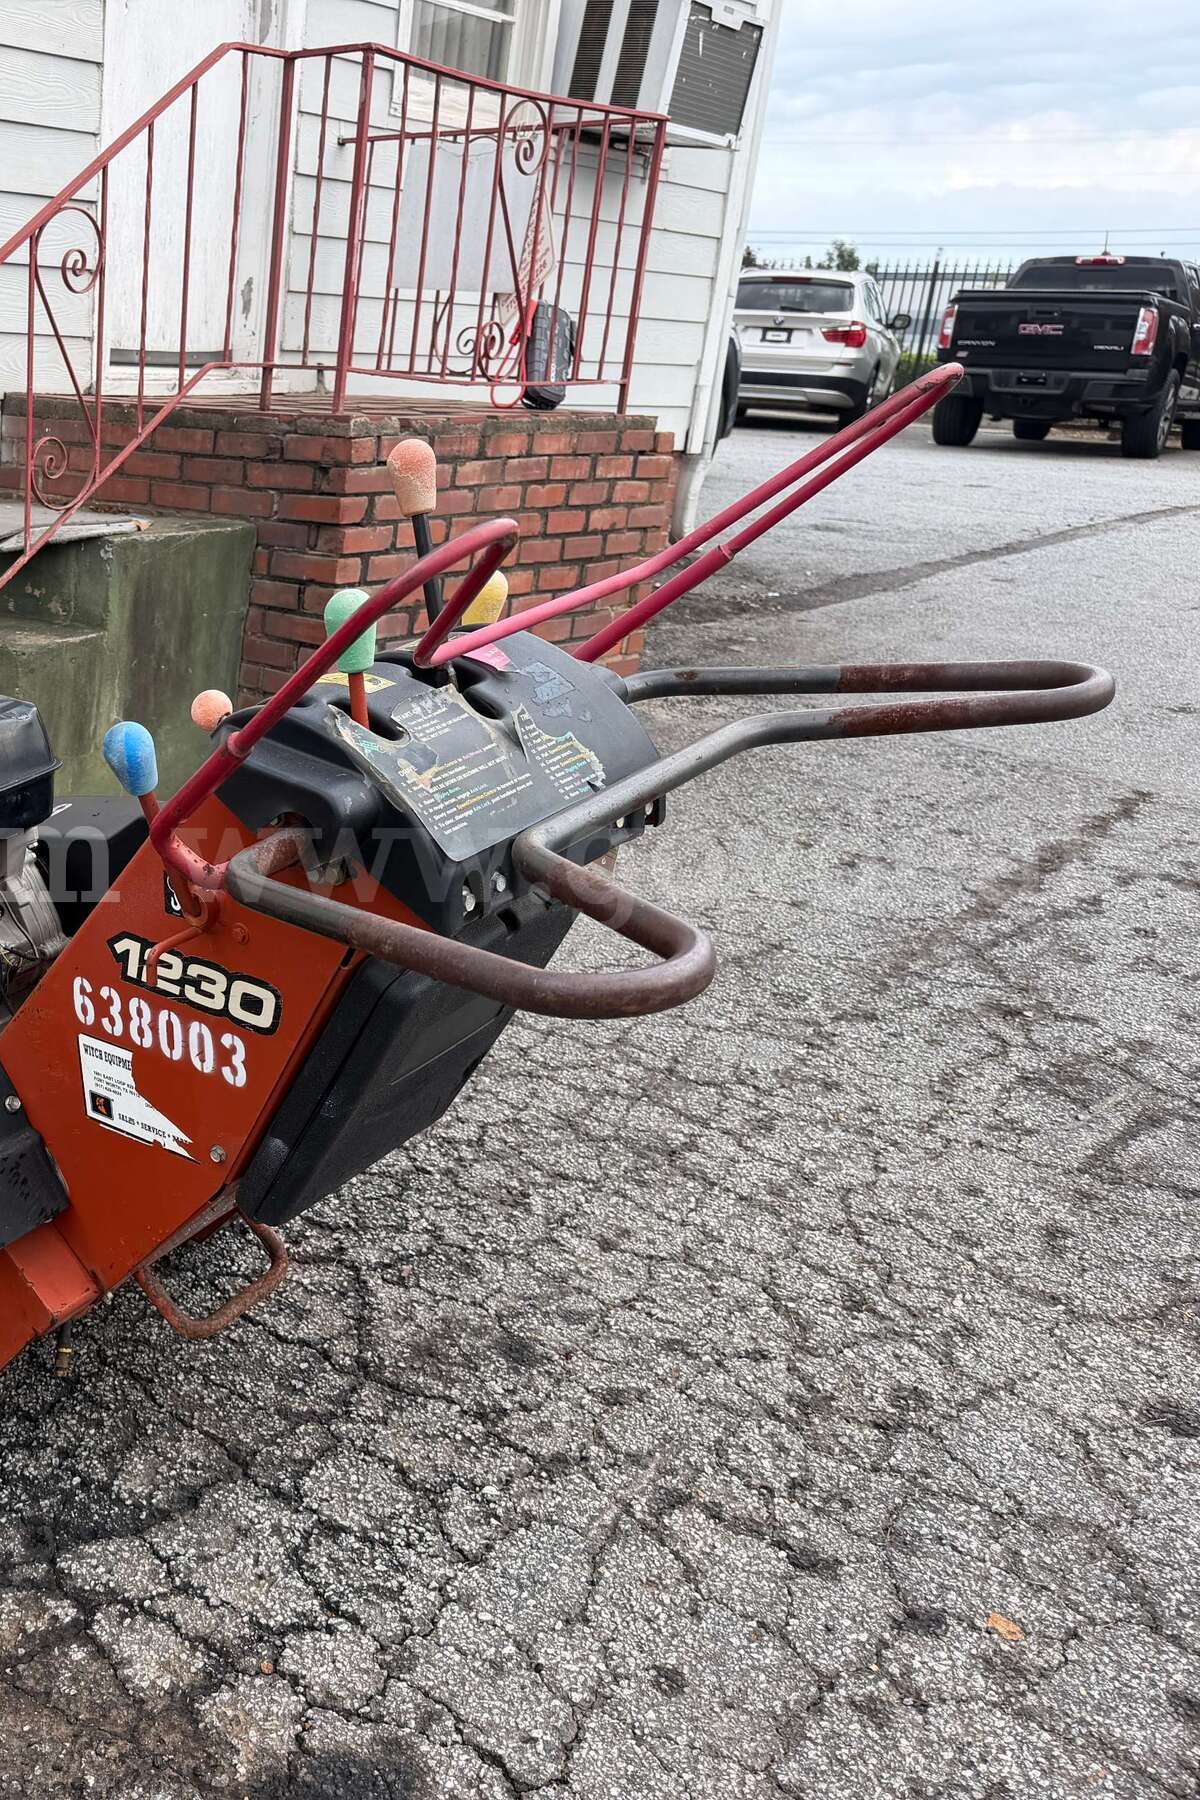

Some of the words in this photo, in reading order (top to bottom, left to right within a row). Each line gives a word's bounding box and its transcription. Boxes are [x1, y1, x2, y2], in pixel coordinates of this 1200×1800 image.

[1018, 323, 1065, 335] GMC
[113, 938, 276, 1029] 1230
[73, 976, 247, 1088] 638003
[83, 1043, 104, 1060] WITCH
[118, 1112, 136, 1126] SALES
[140, 1122, 167, 1139] SERVICE
